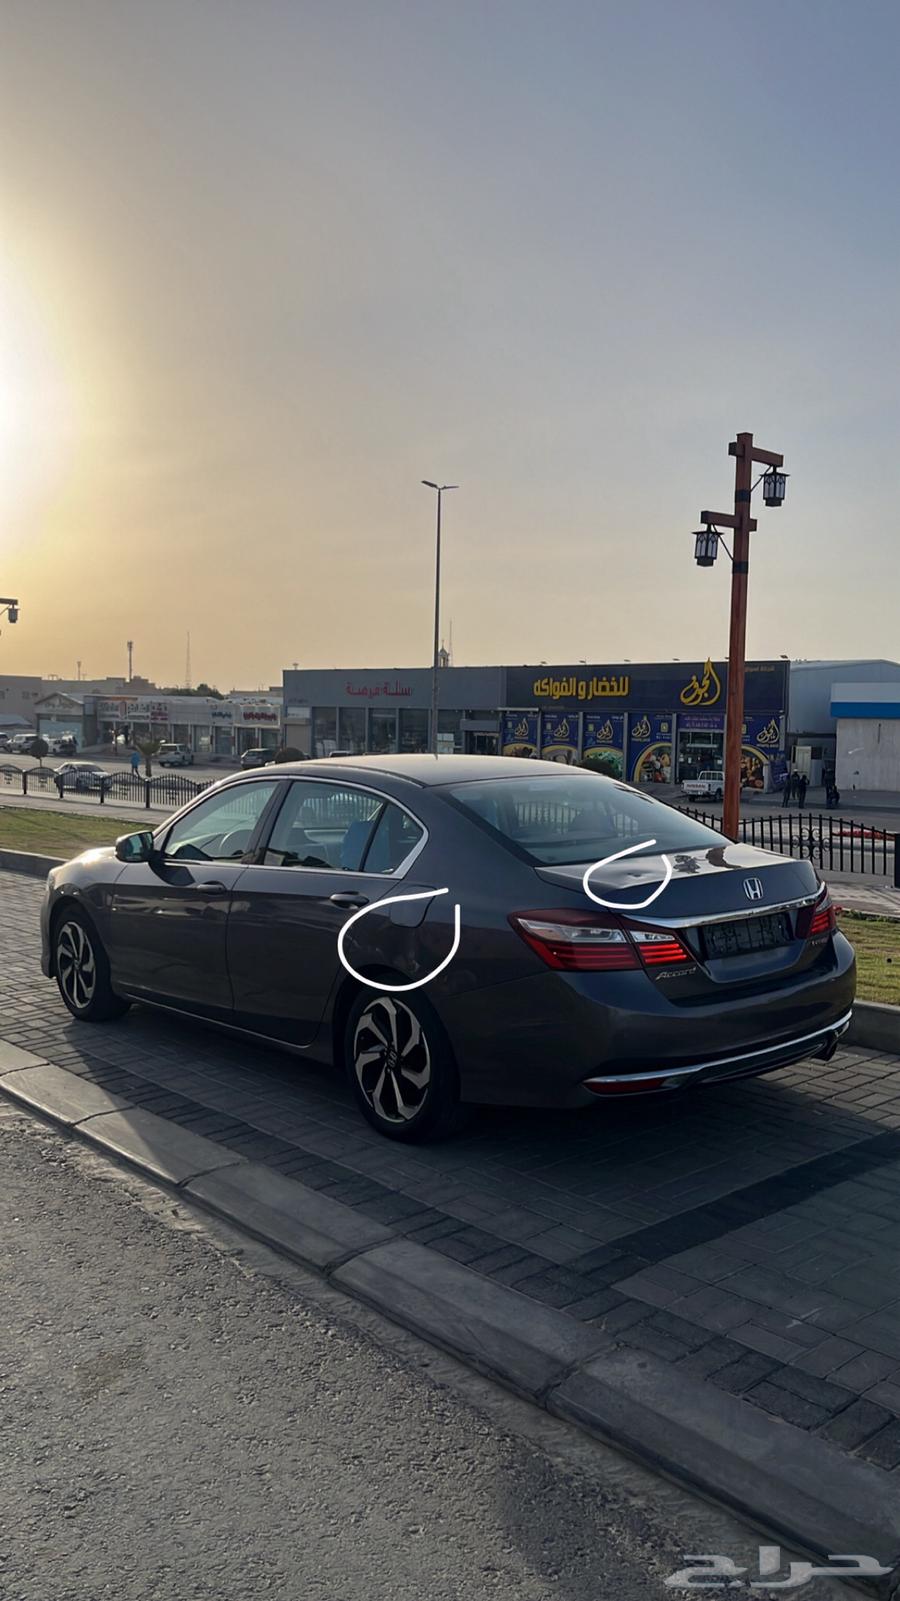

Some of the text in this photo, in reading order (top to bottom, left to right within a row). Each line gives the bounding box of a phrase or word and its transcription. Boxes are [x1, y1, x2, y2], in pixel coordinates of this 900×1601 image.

[533, 677, 576, 700] الفواكه
[587, 676, 629, 700] للخضار
[655, 966, 697, 981] Accord
